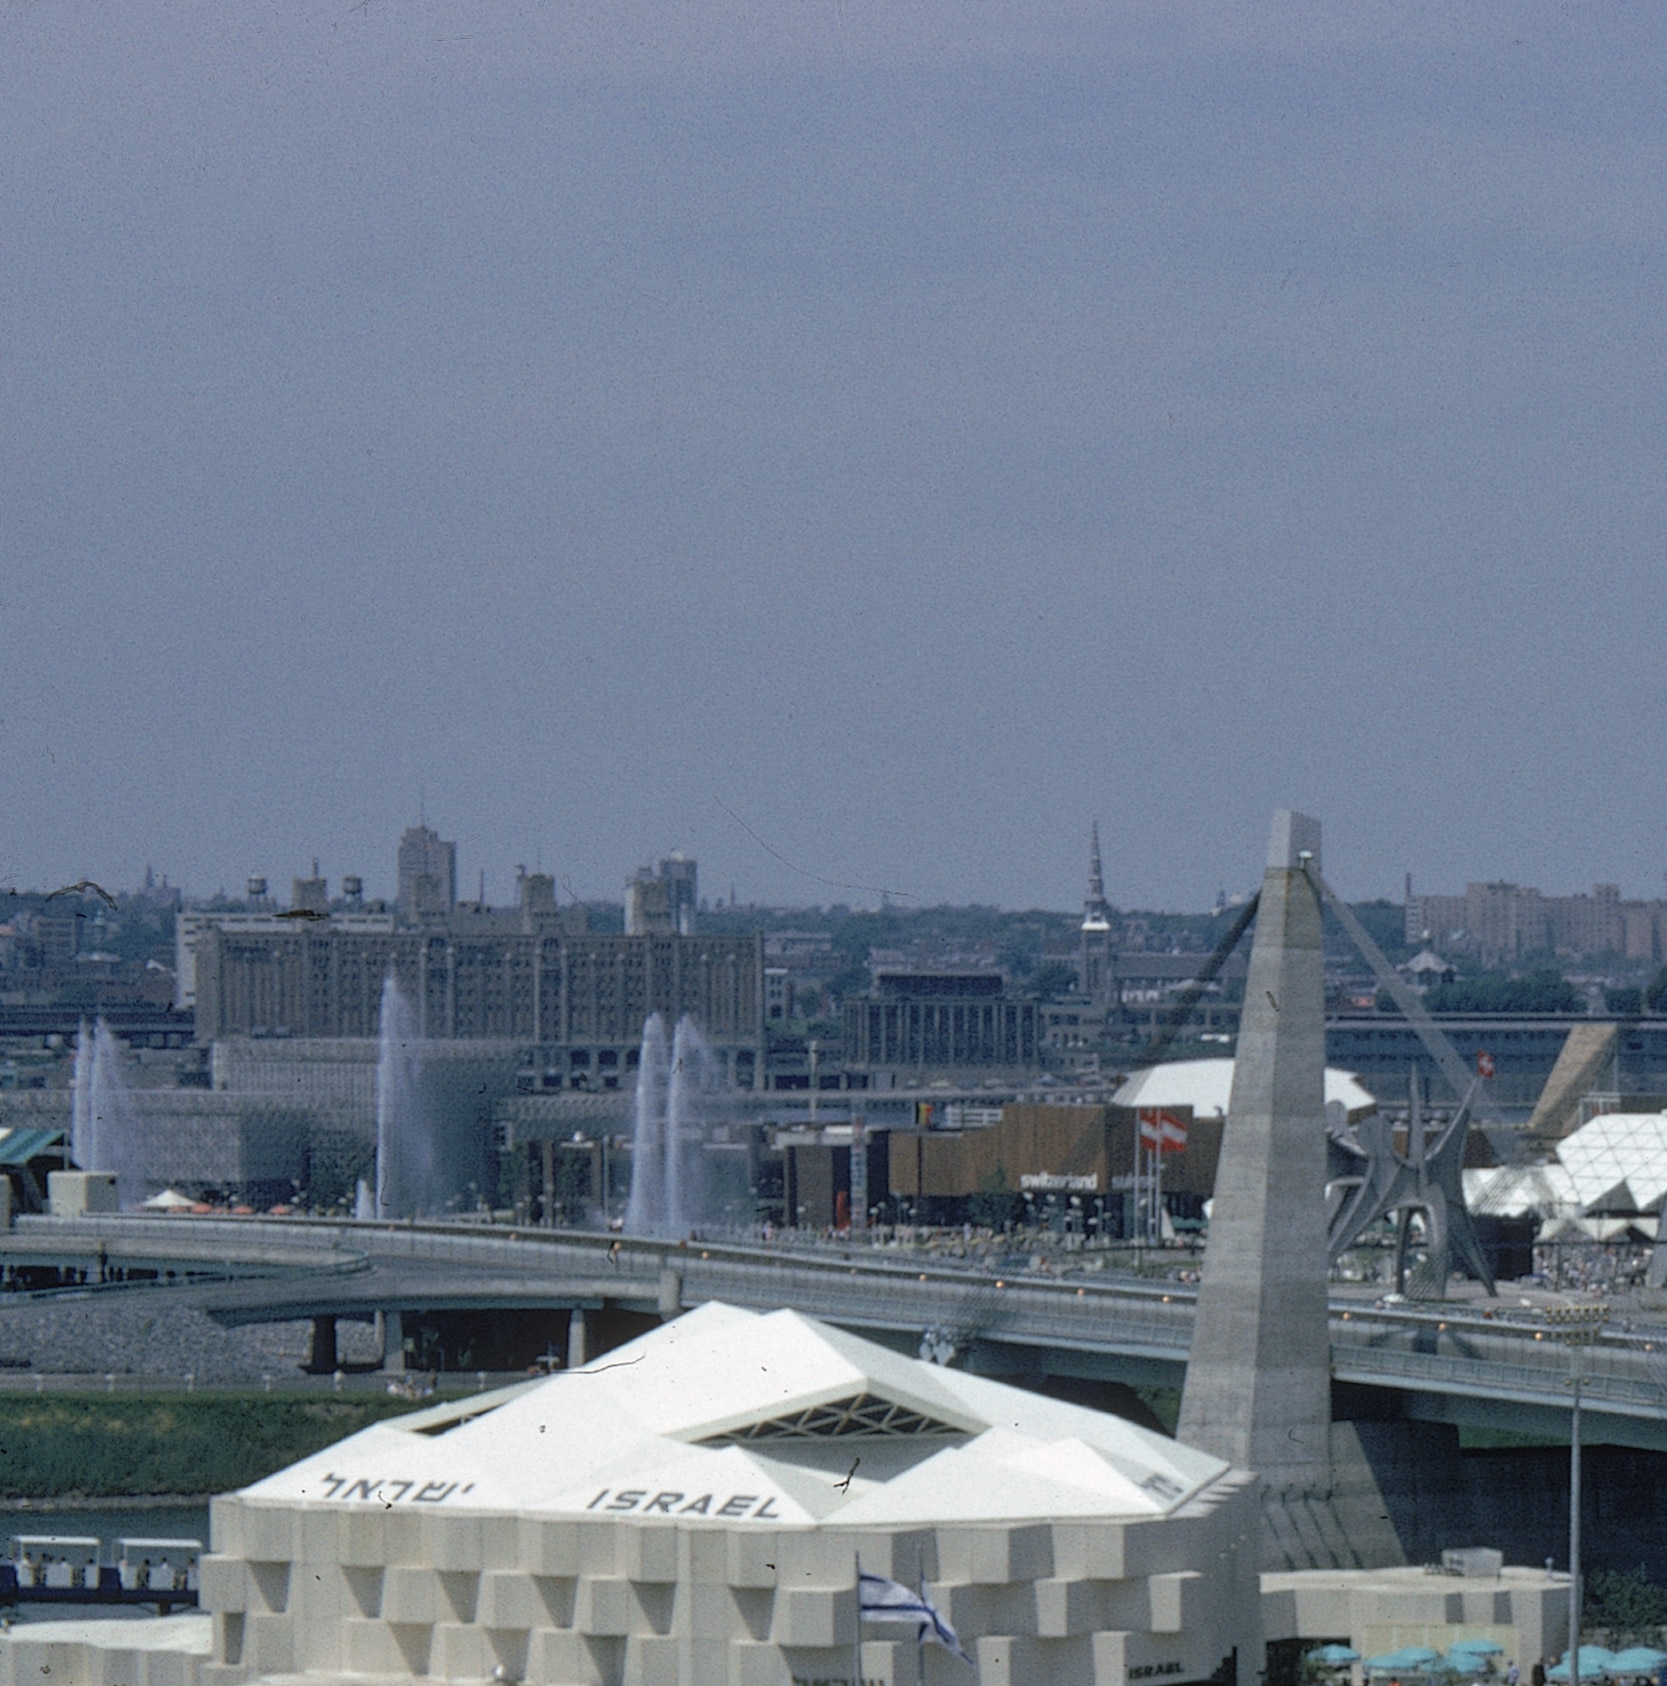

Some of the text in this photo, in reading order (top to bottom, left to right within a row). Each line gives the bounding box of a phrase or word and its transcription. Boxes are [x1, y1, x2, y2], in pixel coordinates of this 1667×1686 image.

[321, 1472, 475, 1502] ישראל
[586, 1488, 780, 1519] ISRAEL
[1129, 1661, 1185, 1680] ISRAEL
